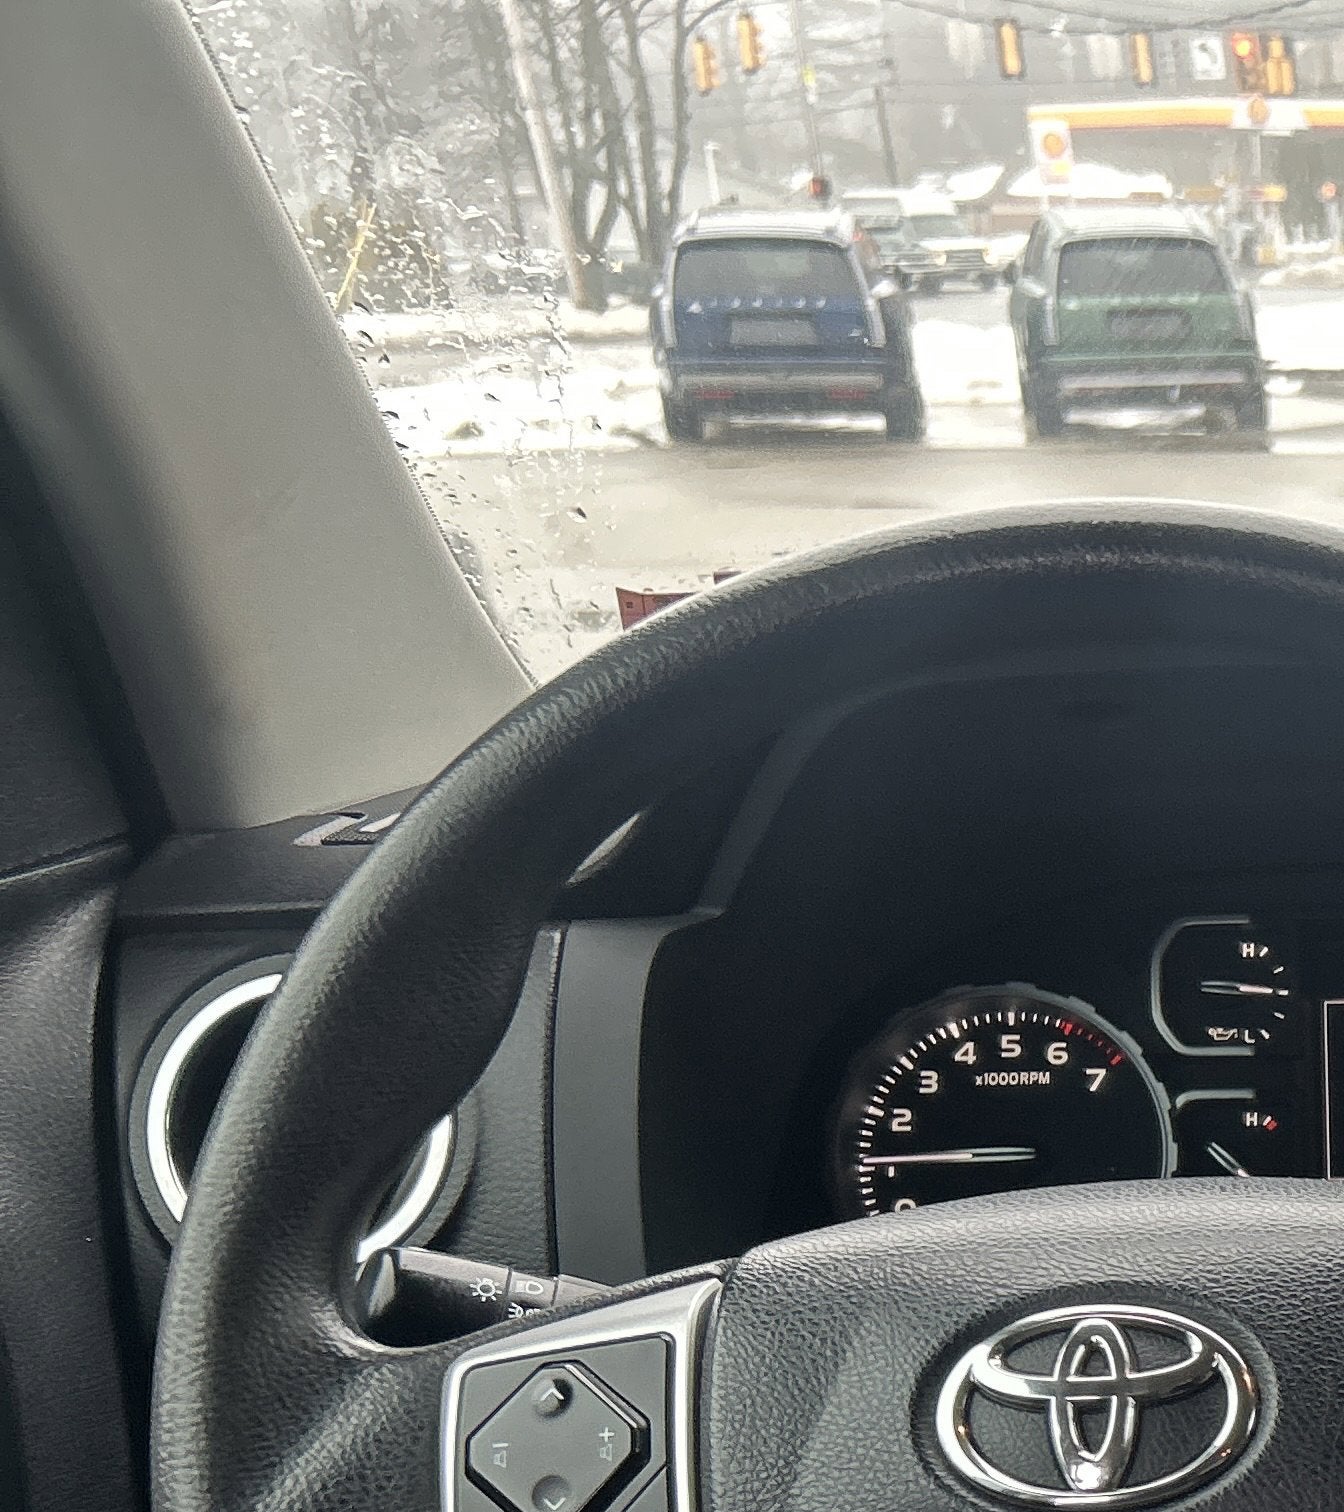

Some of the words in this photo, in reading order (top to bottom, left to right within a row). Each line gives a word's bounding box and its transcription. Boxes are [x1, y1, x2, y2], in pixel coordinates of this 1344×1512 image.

[1000, 1033, 1023, 1059] 5
[1244, 1028, 1256, 1043] L
[954, 1041, 979, 1066] 4
[1046, 1041, 1070, 1066] 6
[918, 1069, 940, 1094] 3
[1085, 1068, 1108, 1093] 7
[890, 1108, 914, 1133] 2
[1245, 1112, 1258, 1127] H
